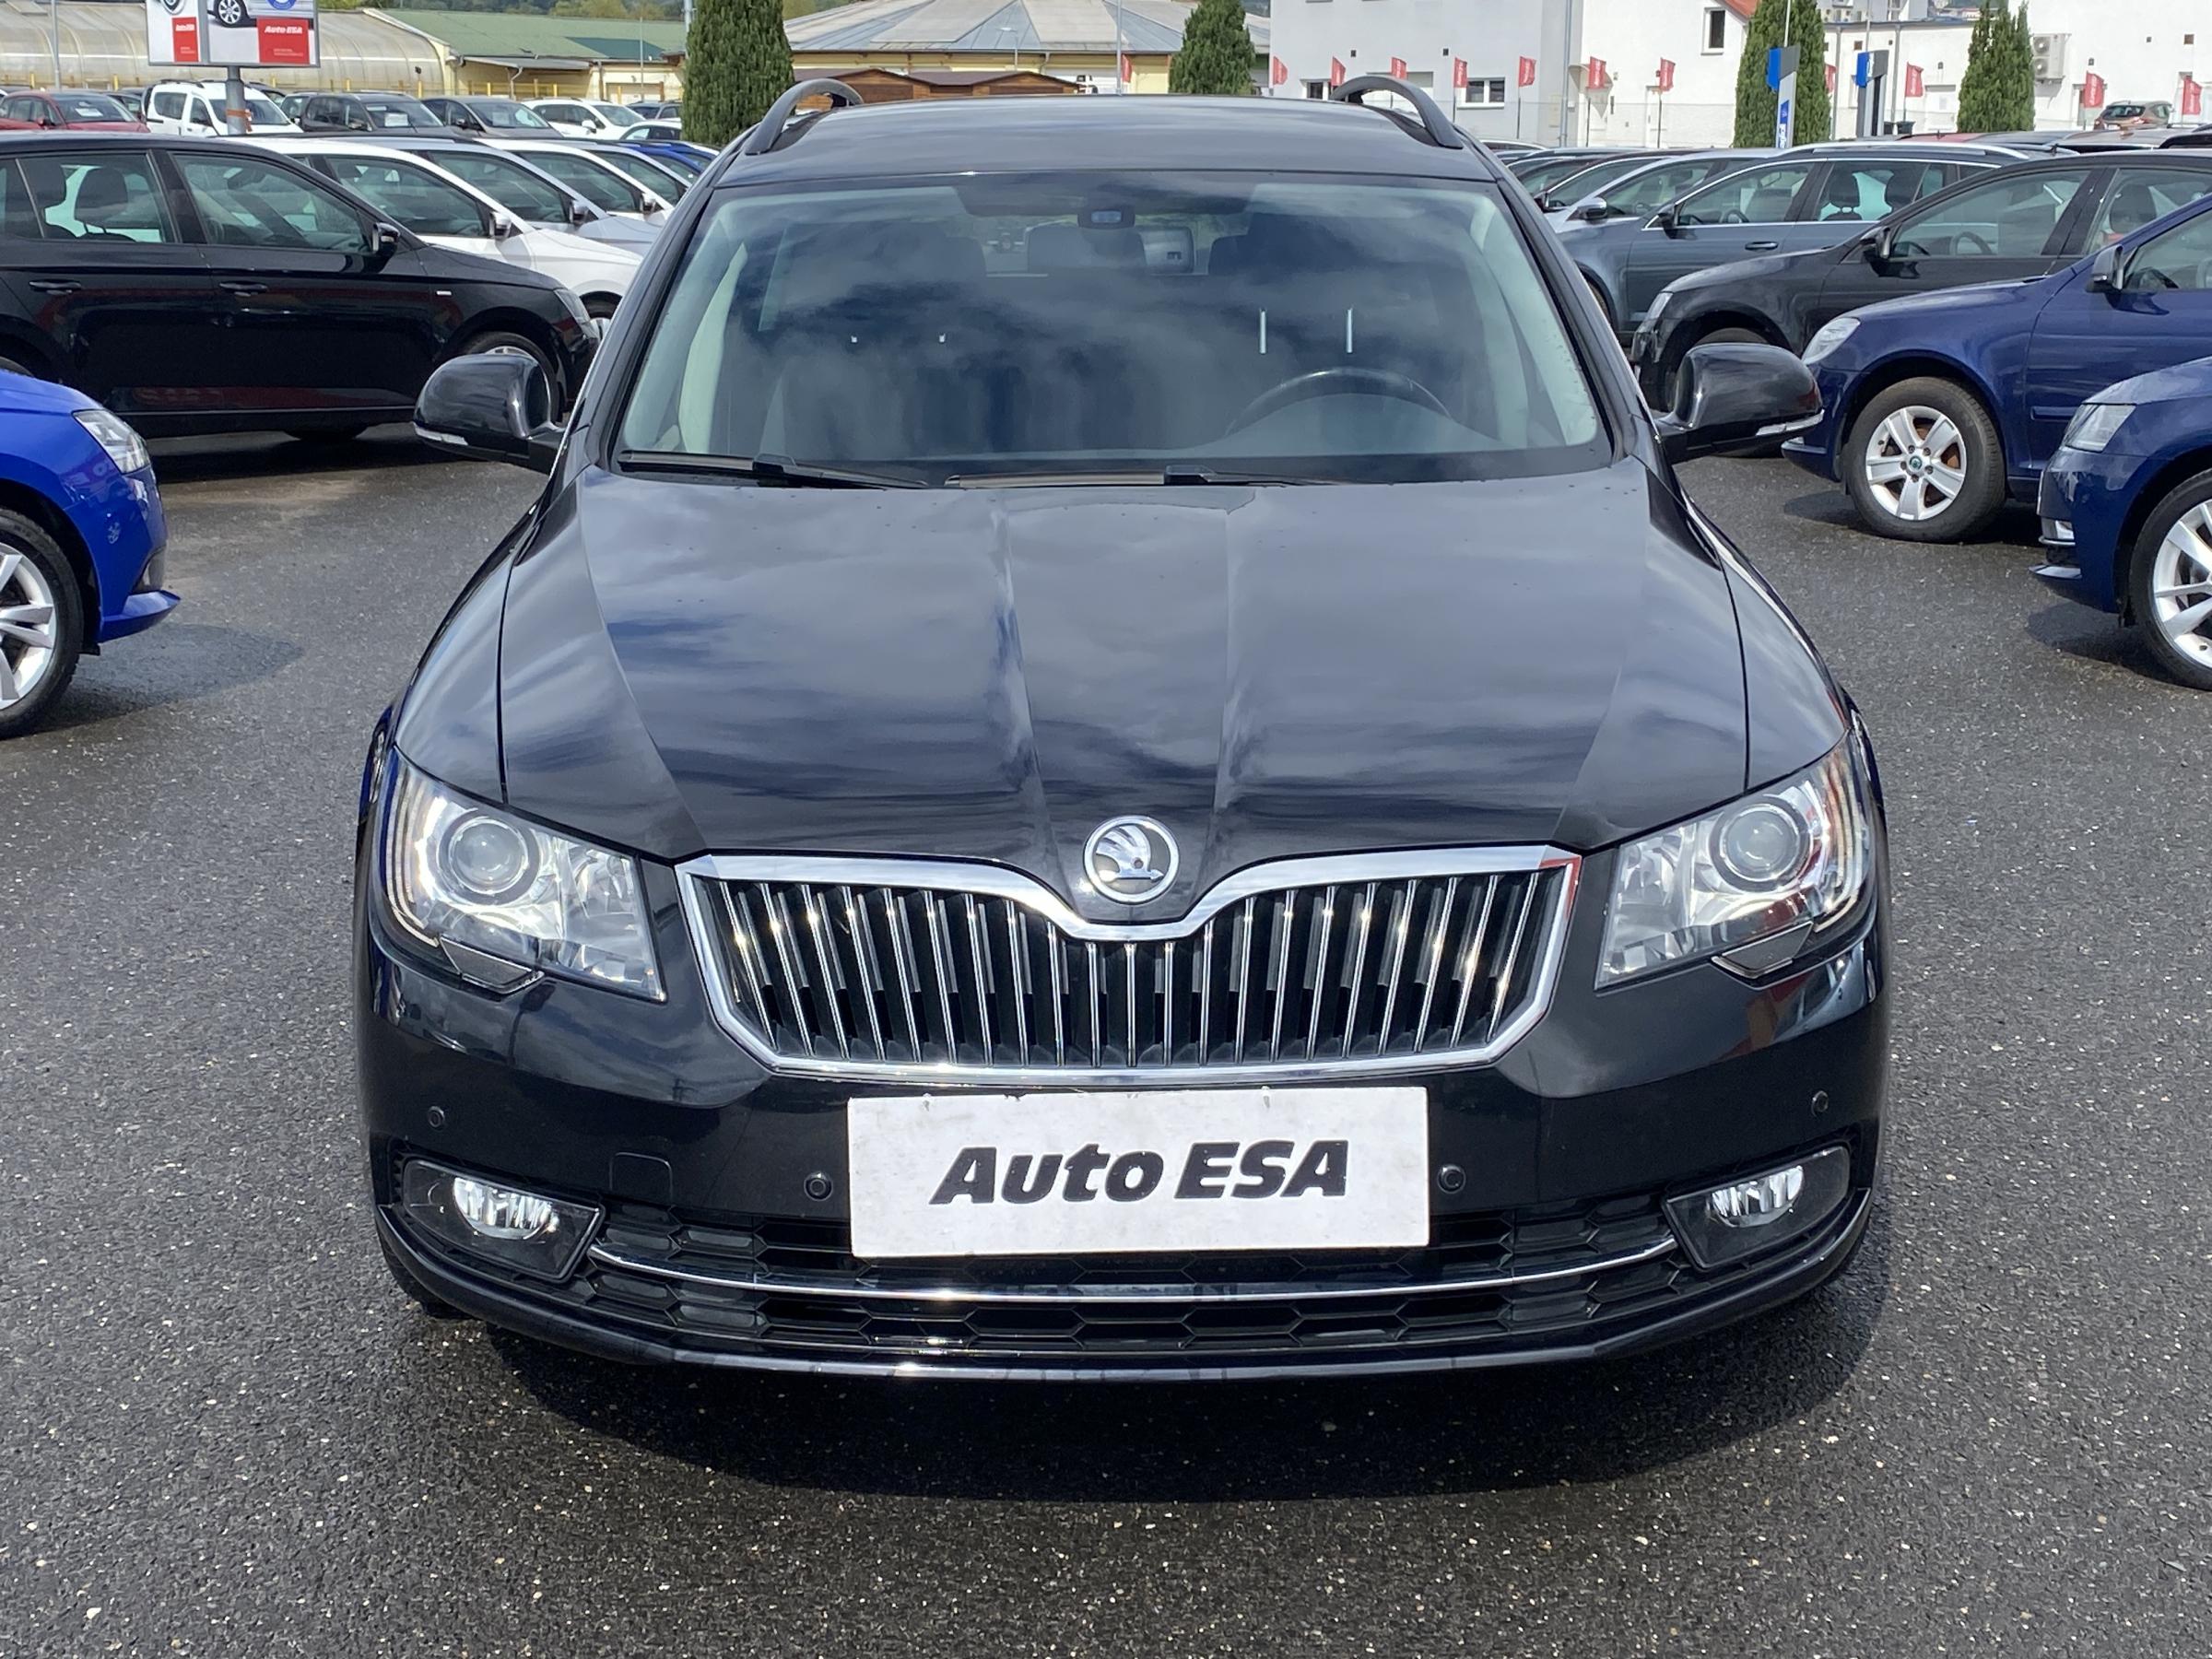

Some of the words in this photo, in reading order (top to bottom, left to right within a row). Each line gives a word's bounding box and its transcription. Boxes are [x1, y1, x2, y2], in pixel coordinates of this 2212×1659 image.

[265, 26, 286, 34] Auto
[929, 1144, 1164, 1205] Auto
[1174, 1139, 1349, 1200] ESA
